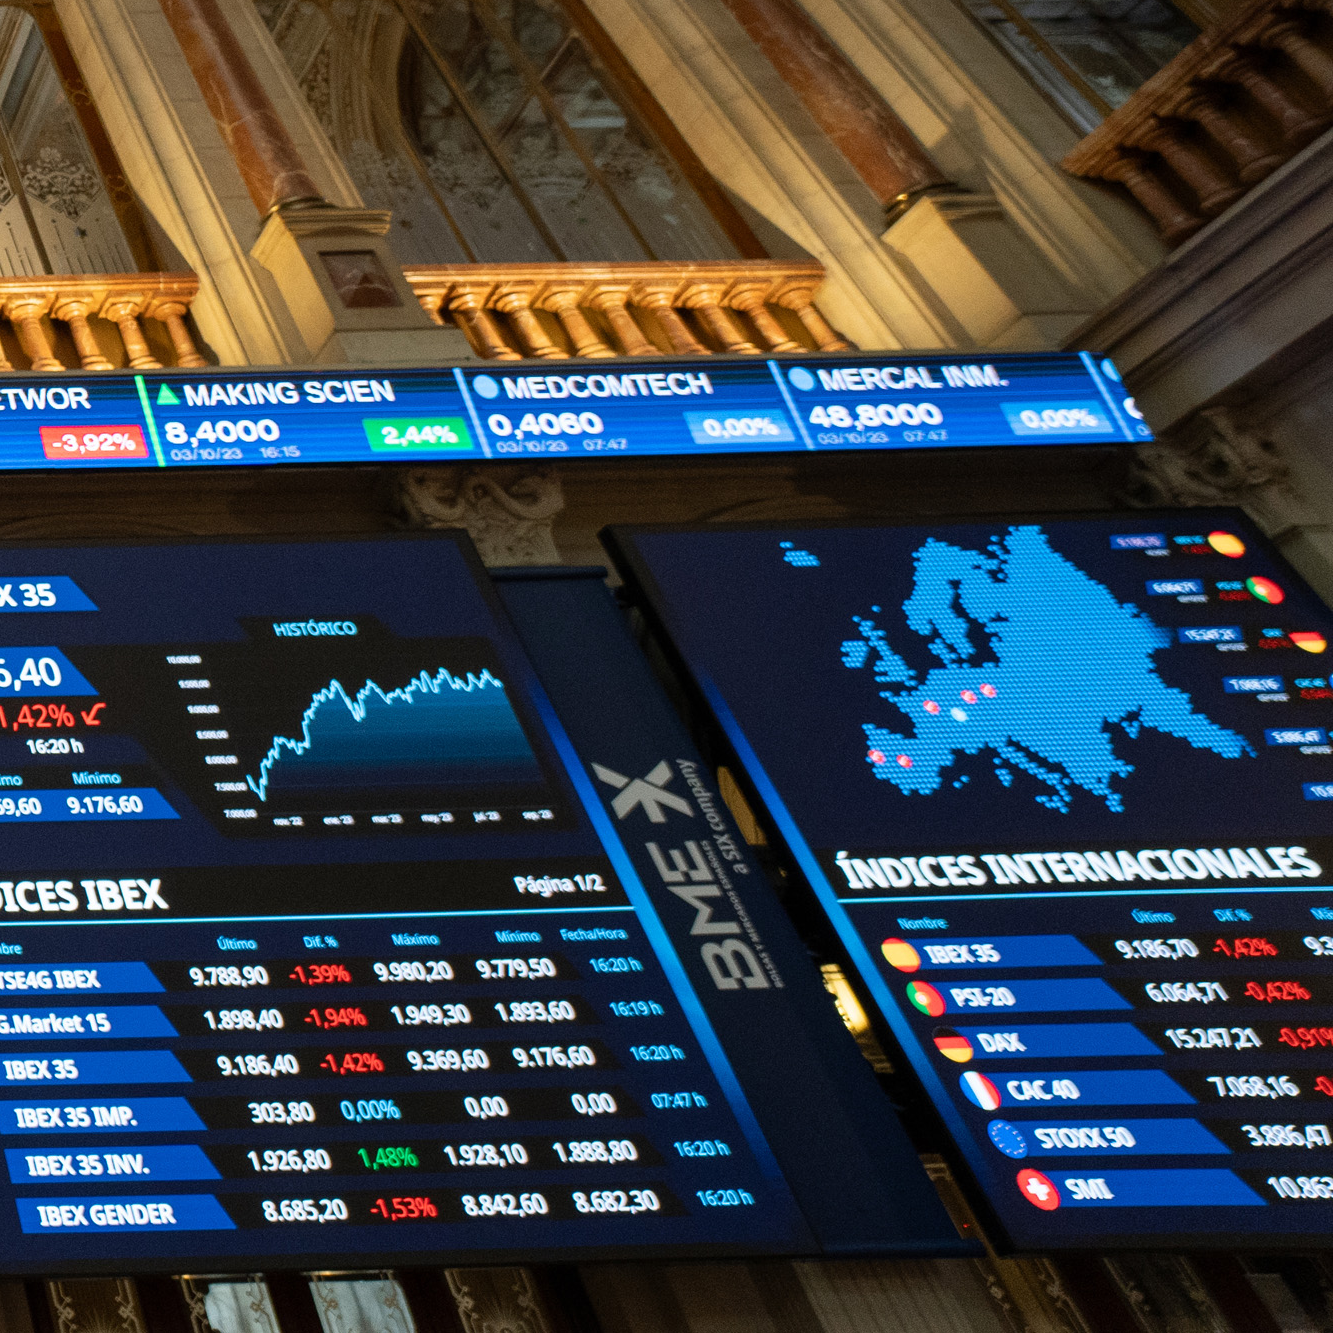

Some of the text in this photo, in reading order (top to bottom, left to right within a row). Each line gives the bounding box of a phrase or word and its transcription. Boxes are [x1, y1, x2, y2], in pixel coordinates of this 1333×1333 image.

[502, 373, 713, 399] MEDCOMTECH
[816, 365, 1009, 392] MERCAL INM.
[183, 380, 395, 406] MAKING SCIEN
[488, 412, 604, 439] 0,4060
[809, 402, 943, 431] 48,8000
[52, 434, 135, 452] -3,92%
[165, 419, 459, 448] 8,4000 2,44%
[19, 583, 56, 606] 35
[273, 619, 358, 637] HISTÓRICO
[72, 772, 122, 784] Mínimo
[835, 846, 1323, 889] ÍNDICES INTERNACIONALES
[80, 879, 169, 911] IBEX
[513, 874, 607, 898] Página 1/2
[644, 840, 771, 990] BME
[922, 943, 1001, 965] IBEX 35
[54, 970, 101, 989] IBEX
[85, 1013, 111, 1032] 15
[976, 1033, 1027, 1053] DAX
[1006, 1079, 1081, 1101] CAC 40
[1034, 1127, 1137, 1149] STOXX 50
[1065, 1179, 1114, 1200] SMI
[37, 1203, 177, 1227] IBEX GENDER
